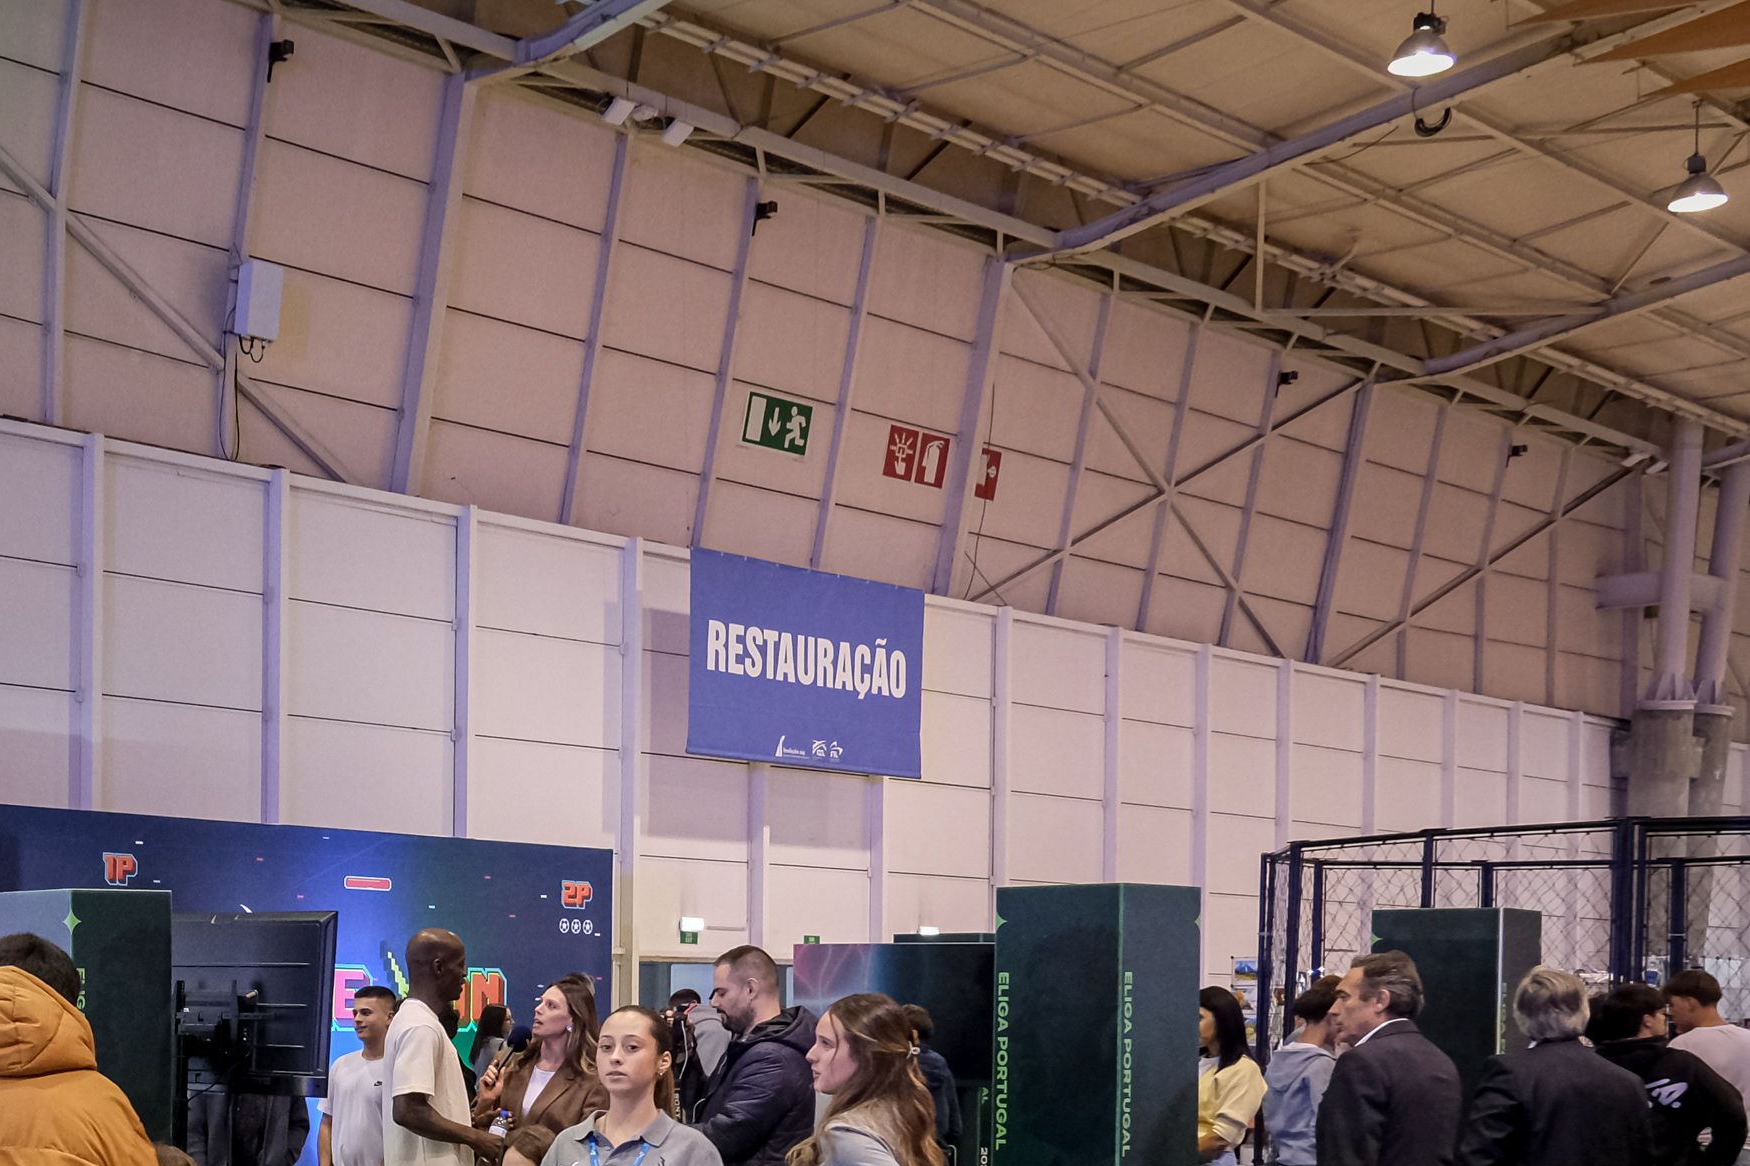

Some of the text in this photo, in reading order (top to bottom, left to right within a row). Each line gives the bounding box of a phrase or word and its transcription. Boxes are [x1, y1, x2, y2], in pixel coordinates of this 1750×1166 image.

[706, 619, 907, 700] RESTAURAÇÃO
[103, 852, 138, 886] 1P
[561, 880, 593, 909] 2P
[995, 972, 1010, 1150] ELIGA PORTUGAL
[1121, 971, 1134, 1158] ELIGA PORTUGAL
